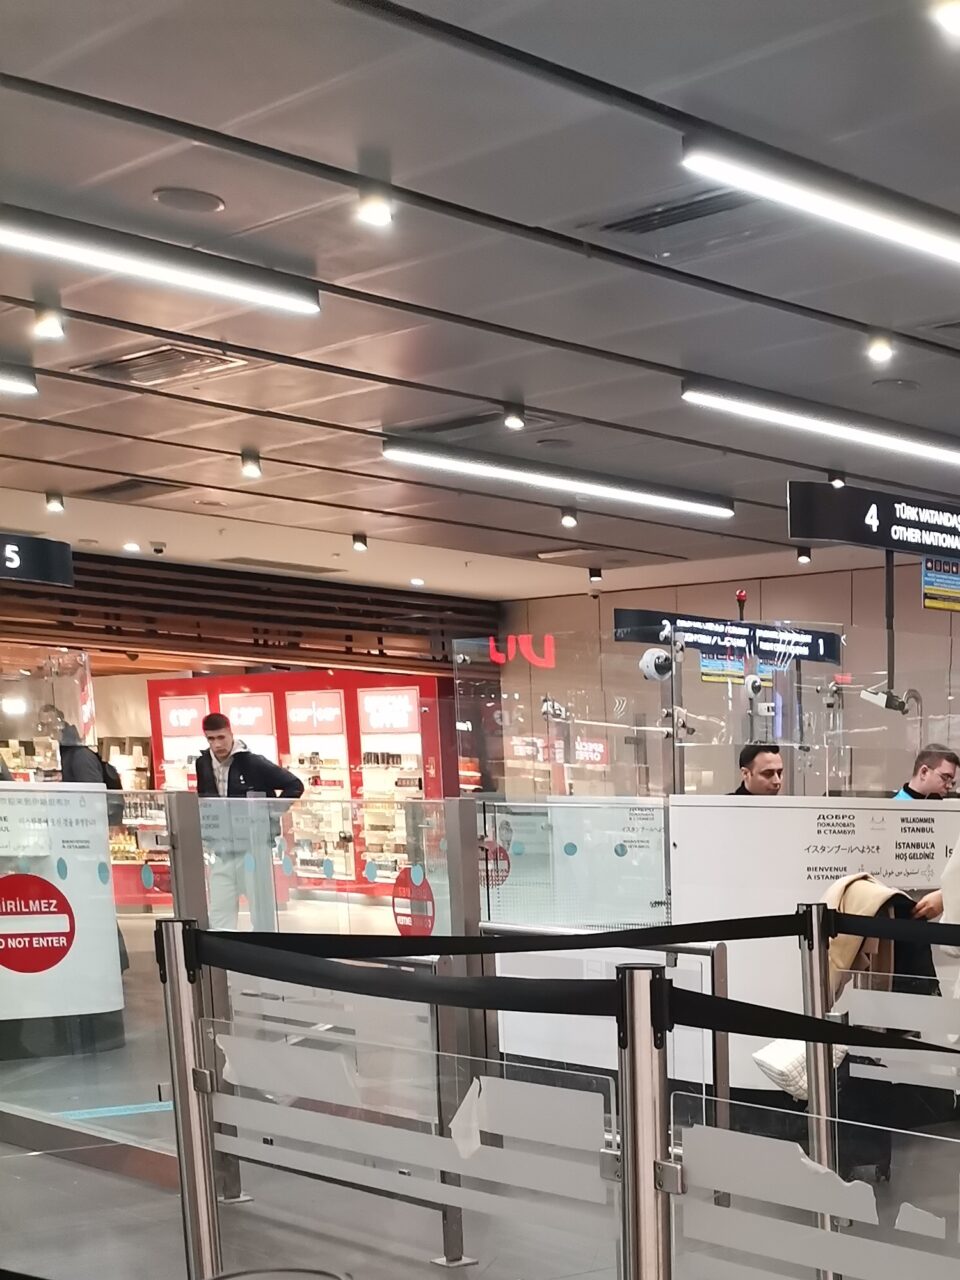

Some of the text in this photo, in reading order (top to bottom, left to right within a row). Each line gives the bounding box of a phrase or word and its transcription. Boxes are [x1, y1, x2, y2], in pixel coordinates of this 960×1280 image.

[864, 503, 879, 532] 4
[894, 502, 918, 521] TÜRK
[891, 525, 921, 543] OTHER
[5, 544, 21, 569] 5
[817, 638, 825, 656] 1
[816, 813, 856, 821] ДОБРО
[900, 816, 935, 824] WILLKOMMEN
[900, 826, 935, 834] ISTANBUL
[804, 845, 881, 855] イスタンブールへようこそ
[895, 852, 908, 862] HOŞ
[908, 851, 935, 861] GELDİNİZ
[0, 897, 58, 913] İRİLMEZ
[7, 937, 31, 949] NOT
[32, 936, 67, 948] ENTER
